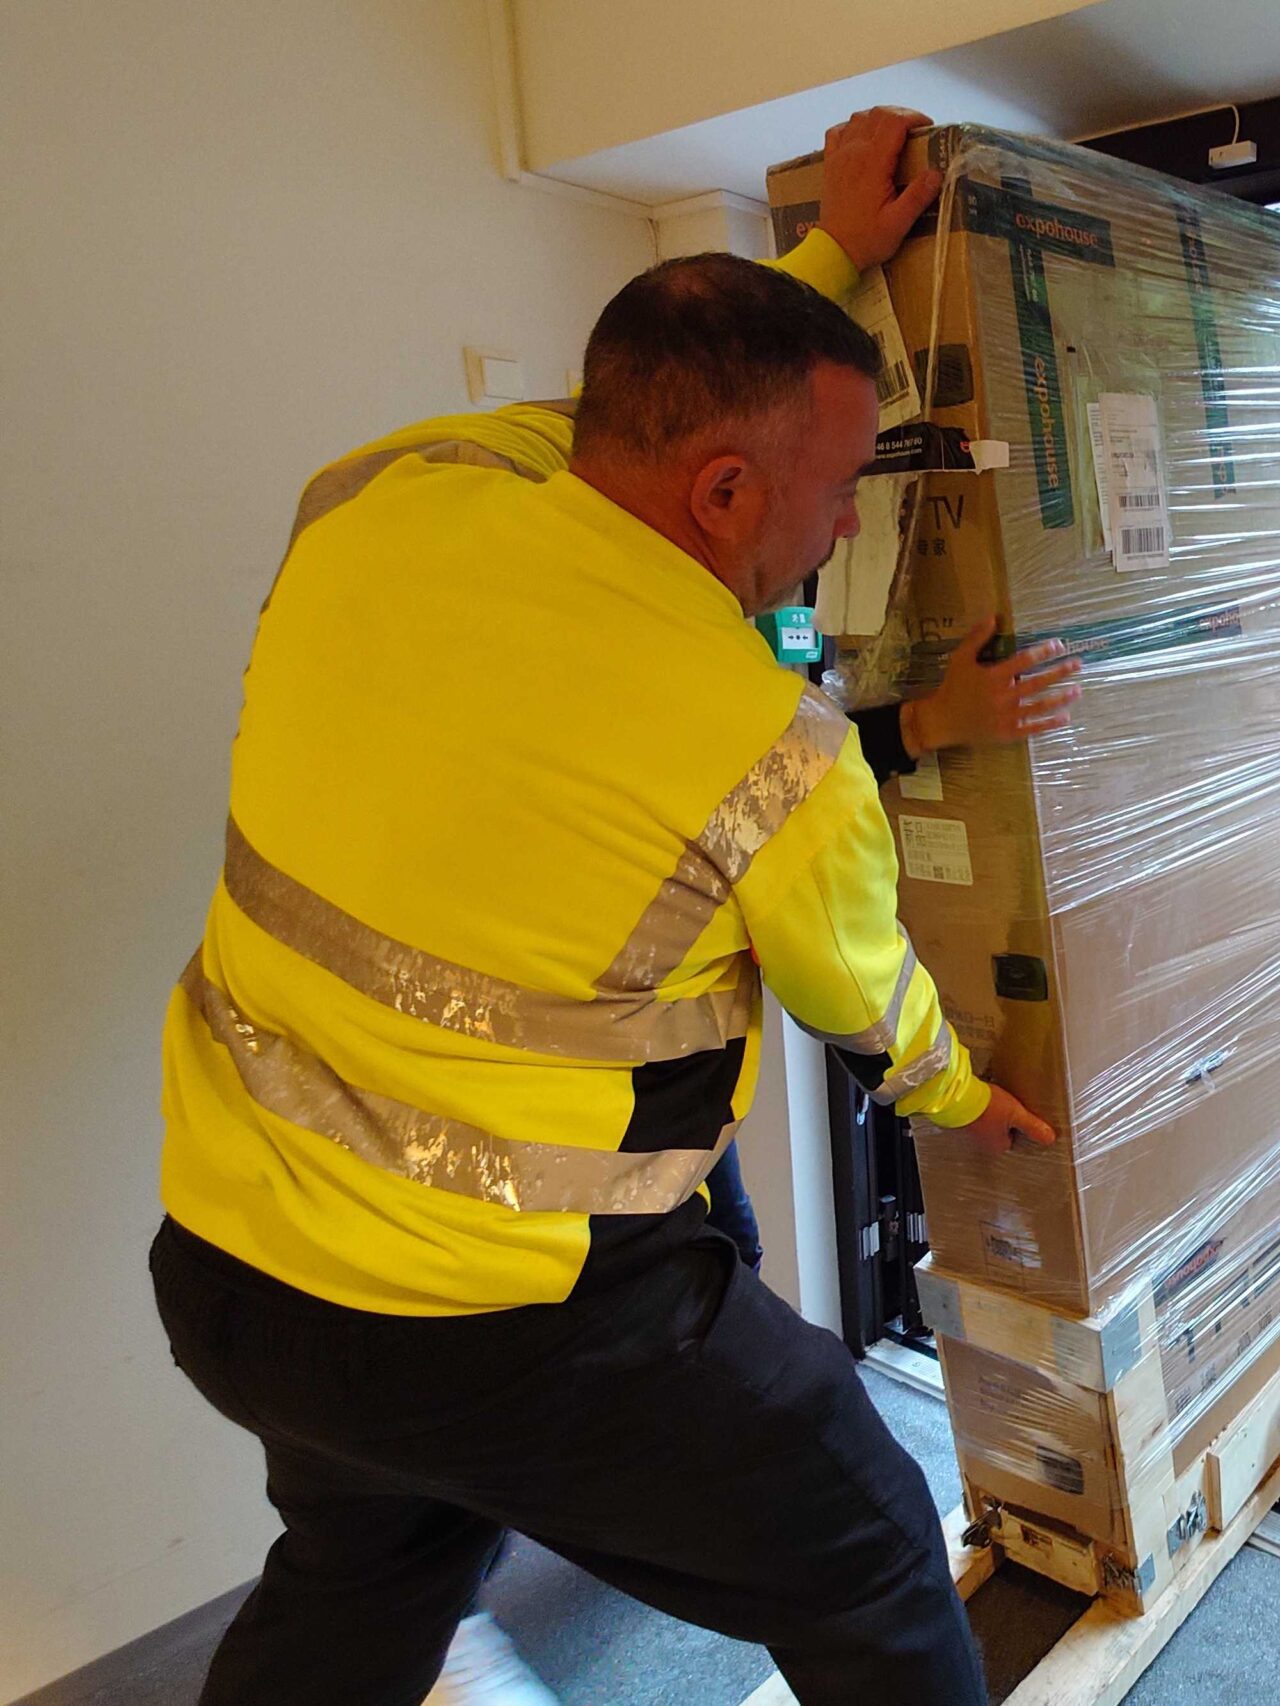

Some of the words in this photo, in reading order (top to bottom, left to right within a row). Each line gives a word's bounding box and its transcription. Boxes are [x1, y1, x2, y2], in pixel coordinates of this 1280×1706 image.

[1015, 211, 1099, 248] expohouse
[1035, 355, 1060, 488] expohouse
[926, 494, 964, 530] TV
